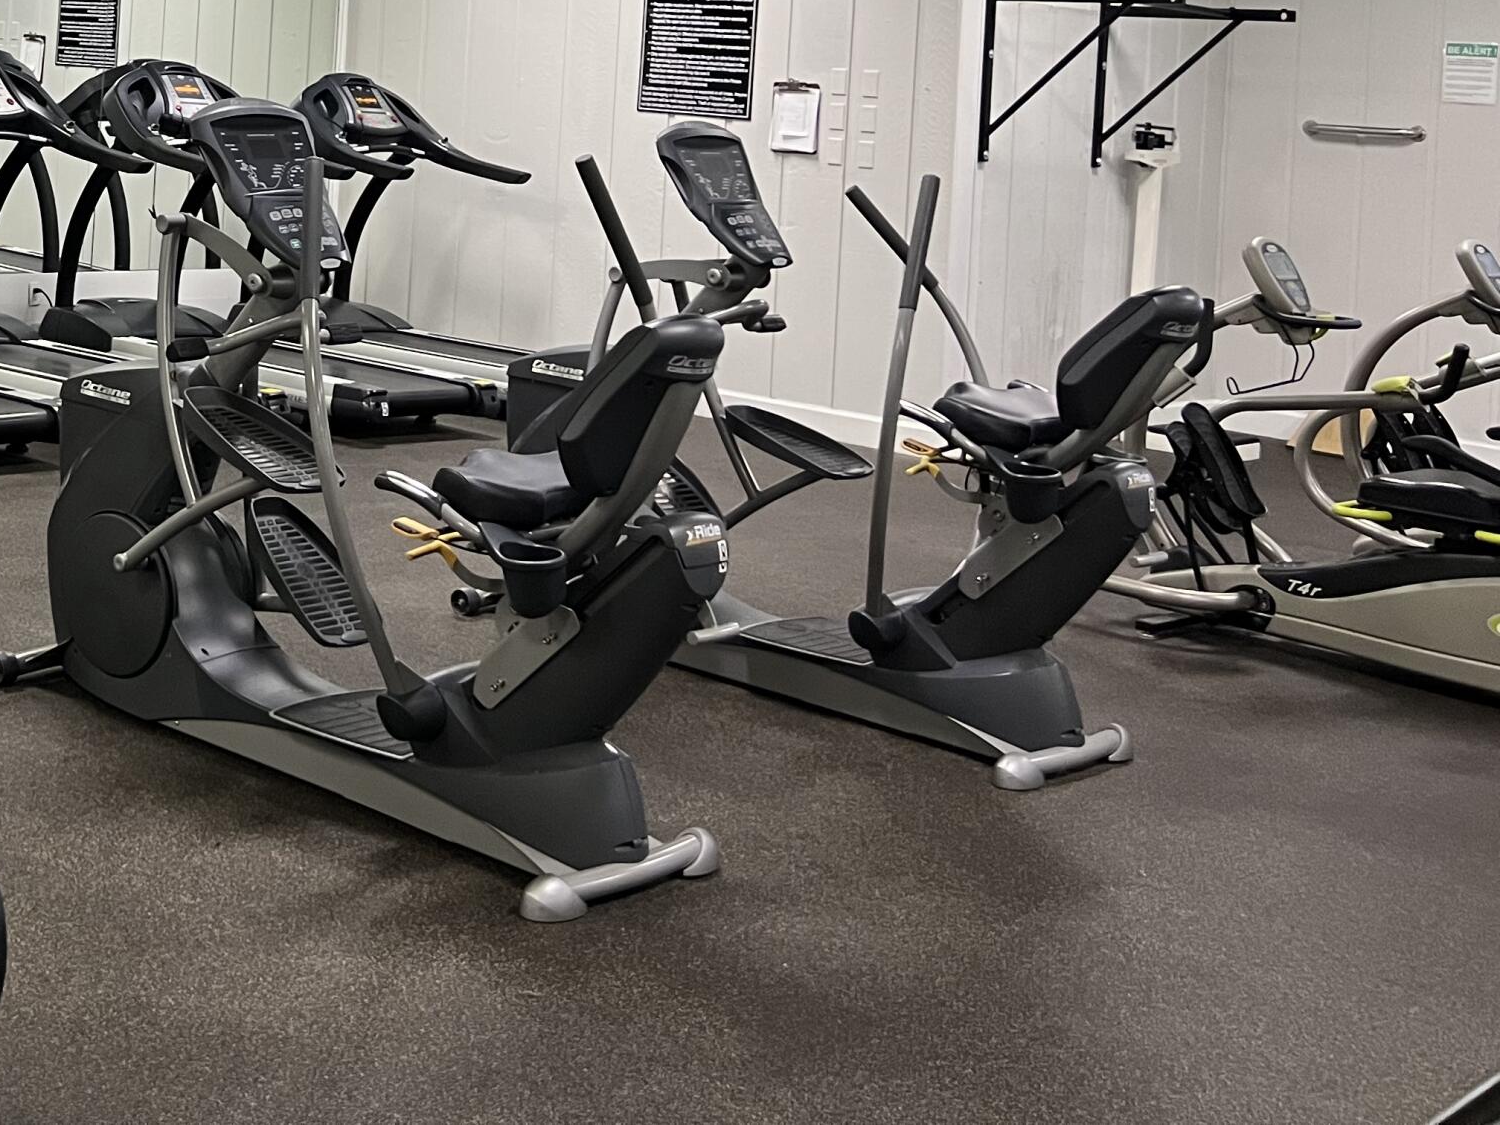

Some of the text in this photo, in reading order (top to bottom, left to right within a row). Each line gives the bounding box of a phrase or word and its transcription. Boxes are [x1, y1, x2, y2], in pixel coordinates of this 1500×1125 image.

[1462, 47, 1492, 56] ALERT
[81, 379, 131, 400] Octane
[1286, 578, 1322, 597] T4r
